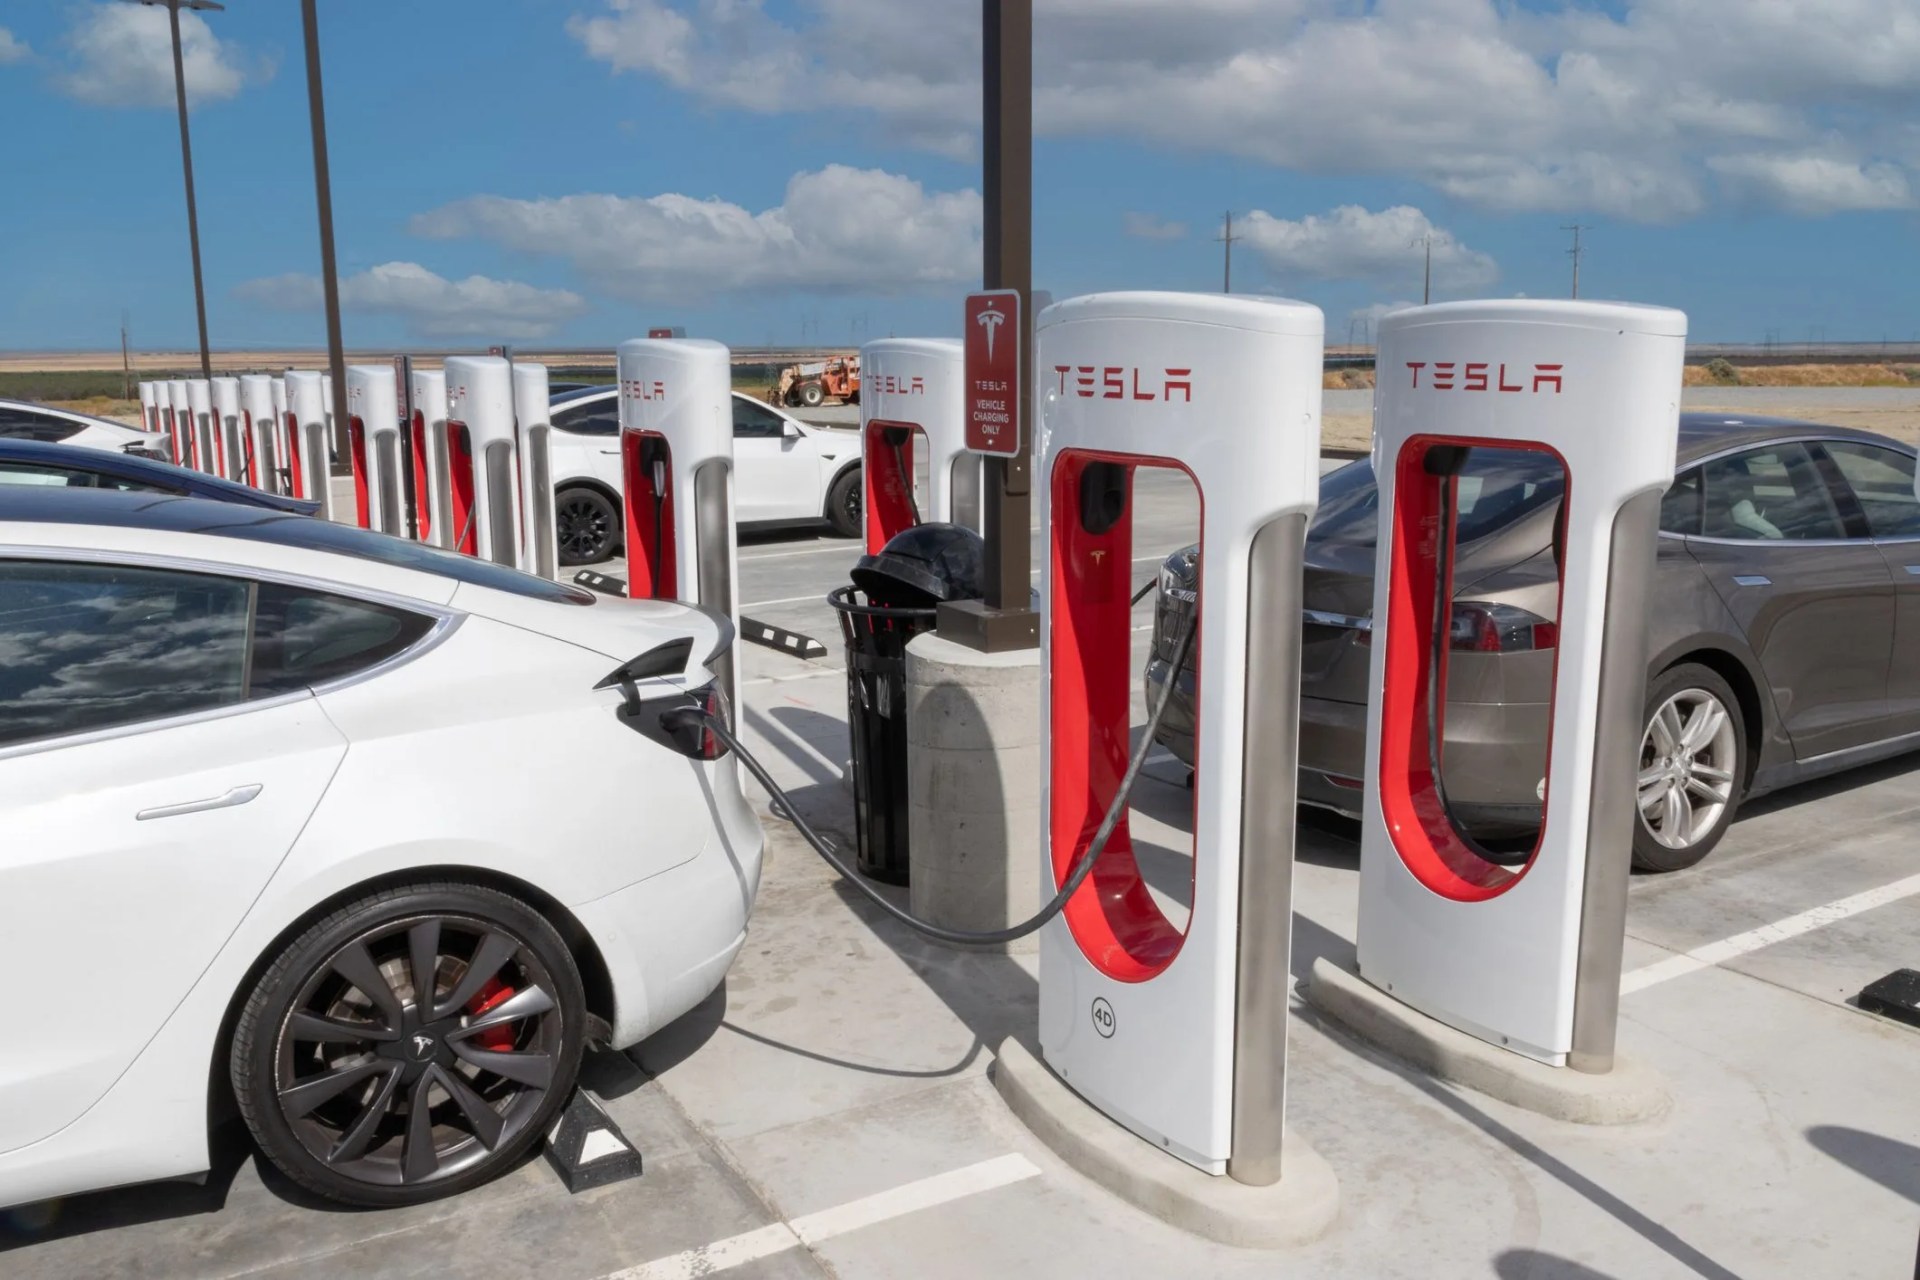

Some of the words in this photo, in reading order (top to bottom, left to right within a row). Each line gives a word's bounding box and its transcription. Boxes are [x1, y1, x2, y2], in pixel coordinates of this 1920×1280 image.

[1054, 366, 1192, 402] TESLA
[1406, 362, 1564, 393] TESLA
[975, 380, 1008, 391] TESLA
[976, 399, 1006, 411] VEHICLE
[973, 411, 1010, 424] CHARGING
[981, 424, 1001, 435] ONLY
[1094, 1007, 1113, 1028] 4D
